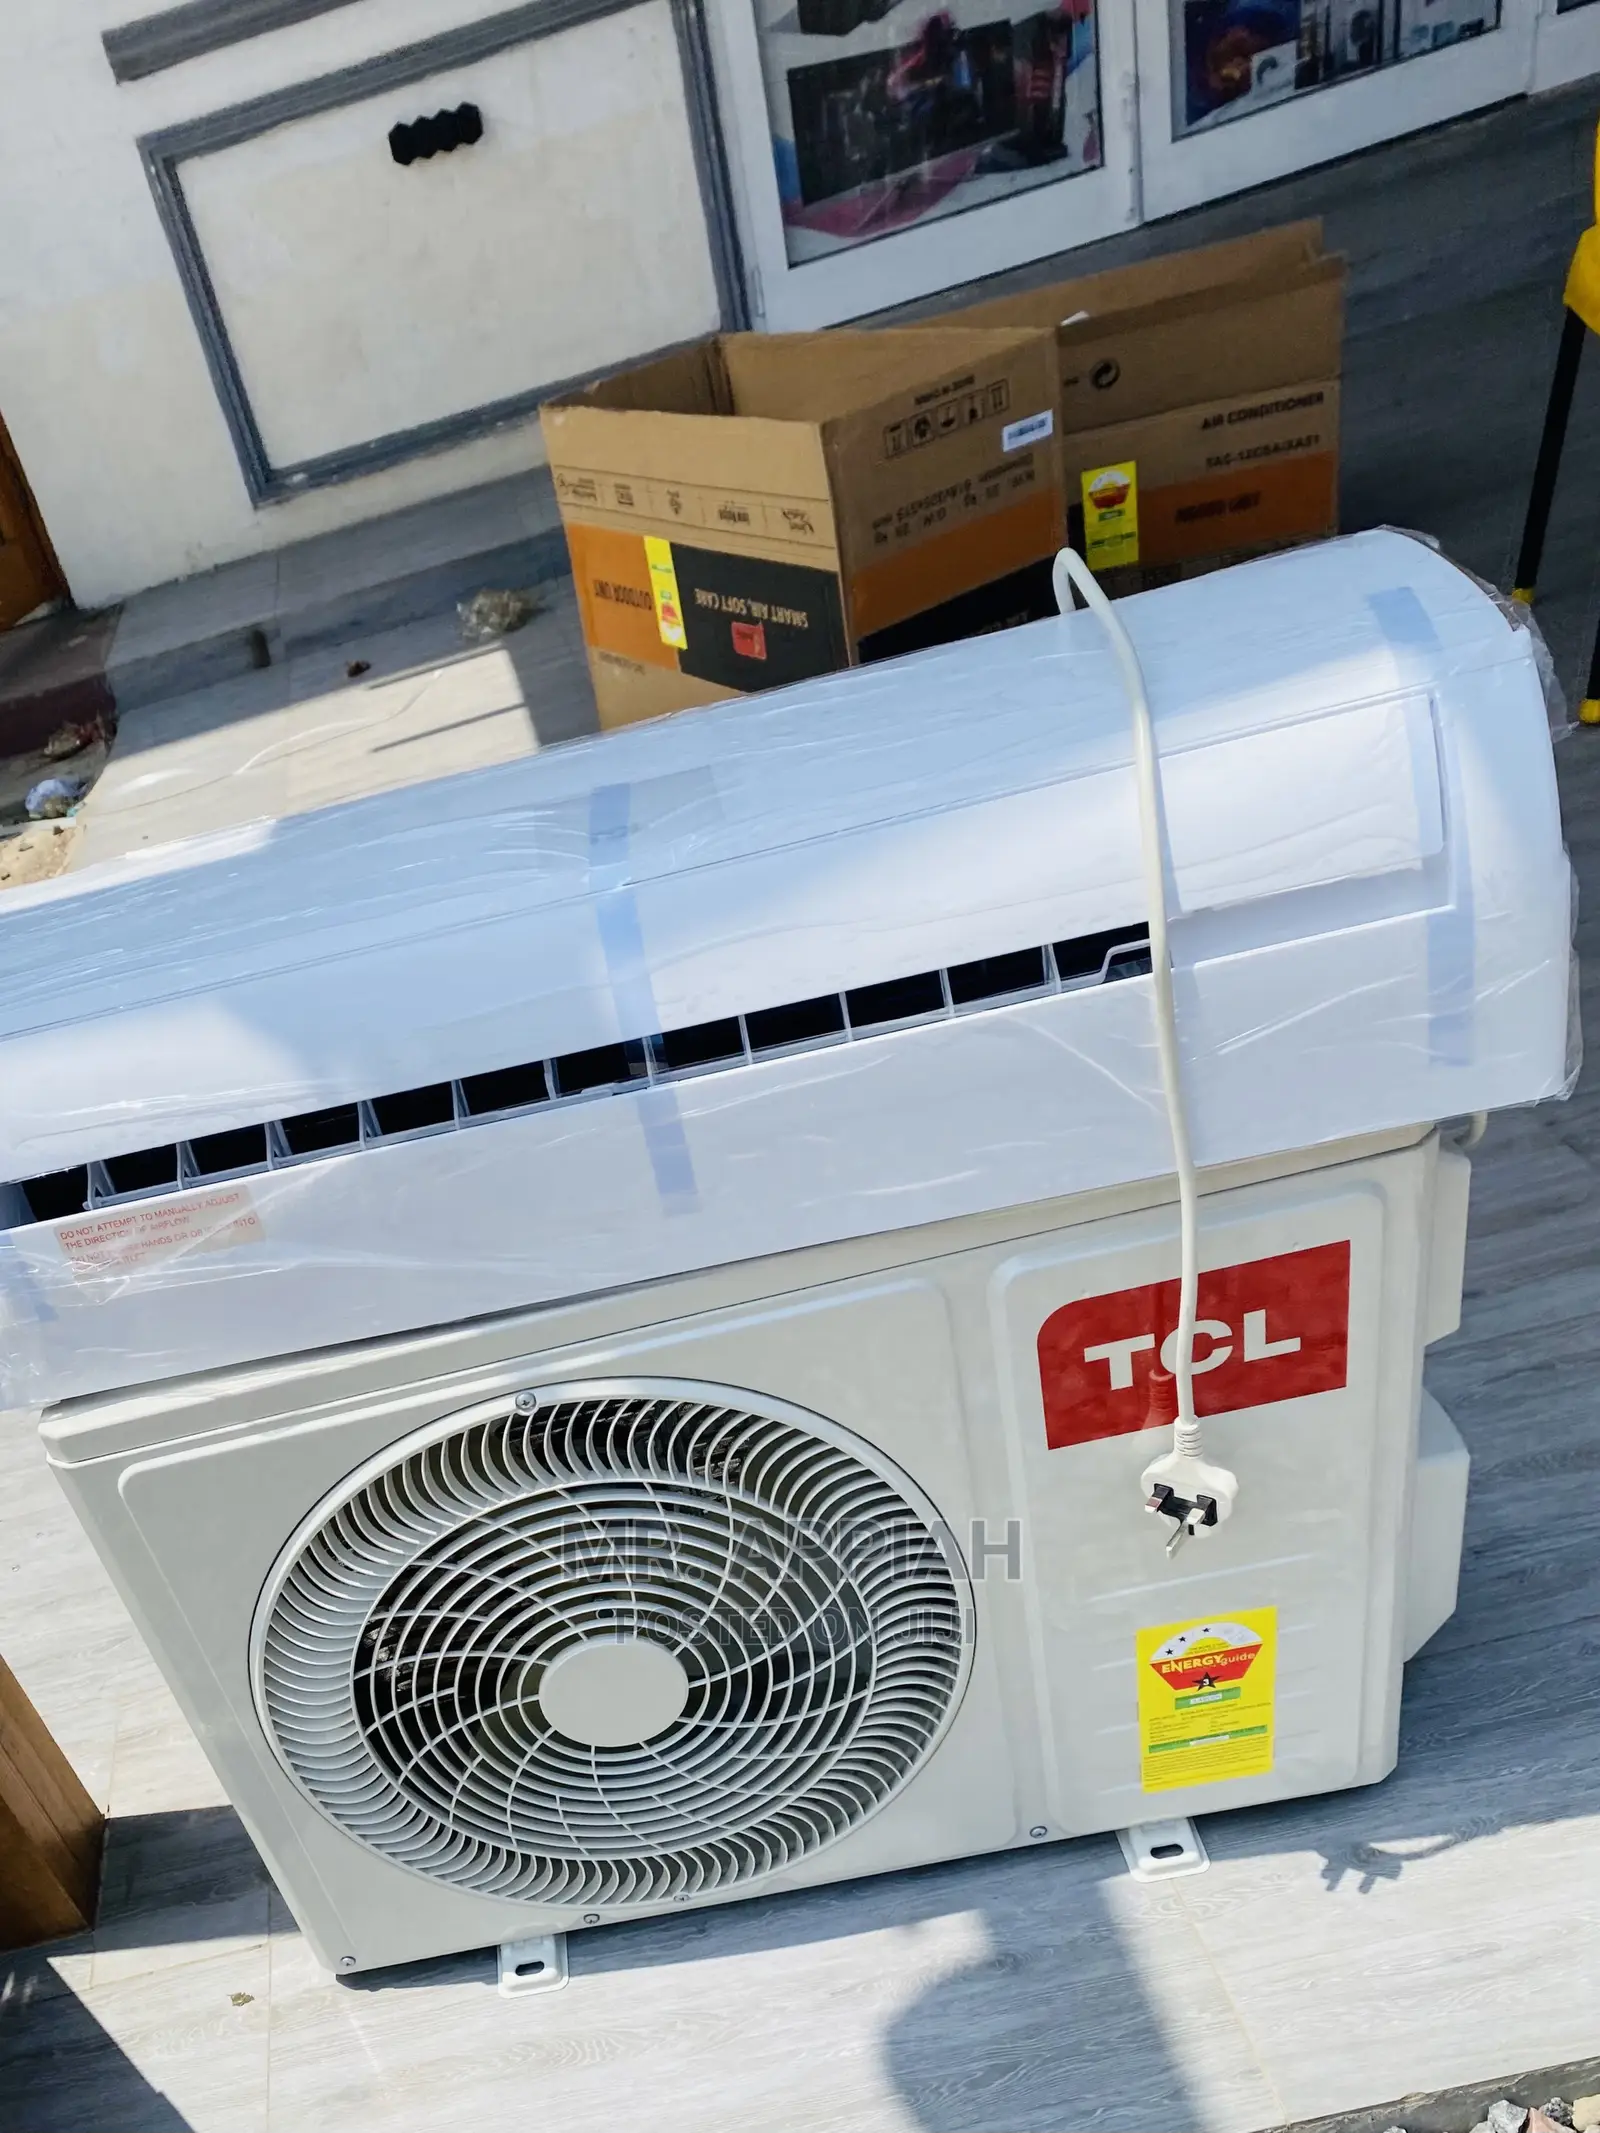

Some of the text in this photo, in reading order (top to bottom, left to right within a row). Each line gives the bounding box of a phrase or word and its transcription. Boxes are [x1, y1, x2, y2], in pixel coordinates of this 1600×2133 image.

[1201, 391, 1324, 431] AIR CONDITIONER
[594, 580, 612, 601] UNIT
[614, 582, 652, 611] OUTDOOR
[693, 587, 719, 611] CARE
[721, 594, 747, 617] SOFT
[771, 604, 809, 629] SMART
[59, 1193, 240, 1242] DO NOT ATTEMPT TO MANUALLY ADJUST
[64, 1240, 83, 1251] THE
[84, 1228, 134, 1246] DIRECTIO
[141, 1235, 173, 1249] HANDS
[174, 1231, 189, 1242] OR
[1084, 1309, 1301, 1391] TCL
